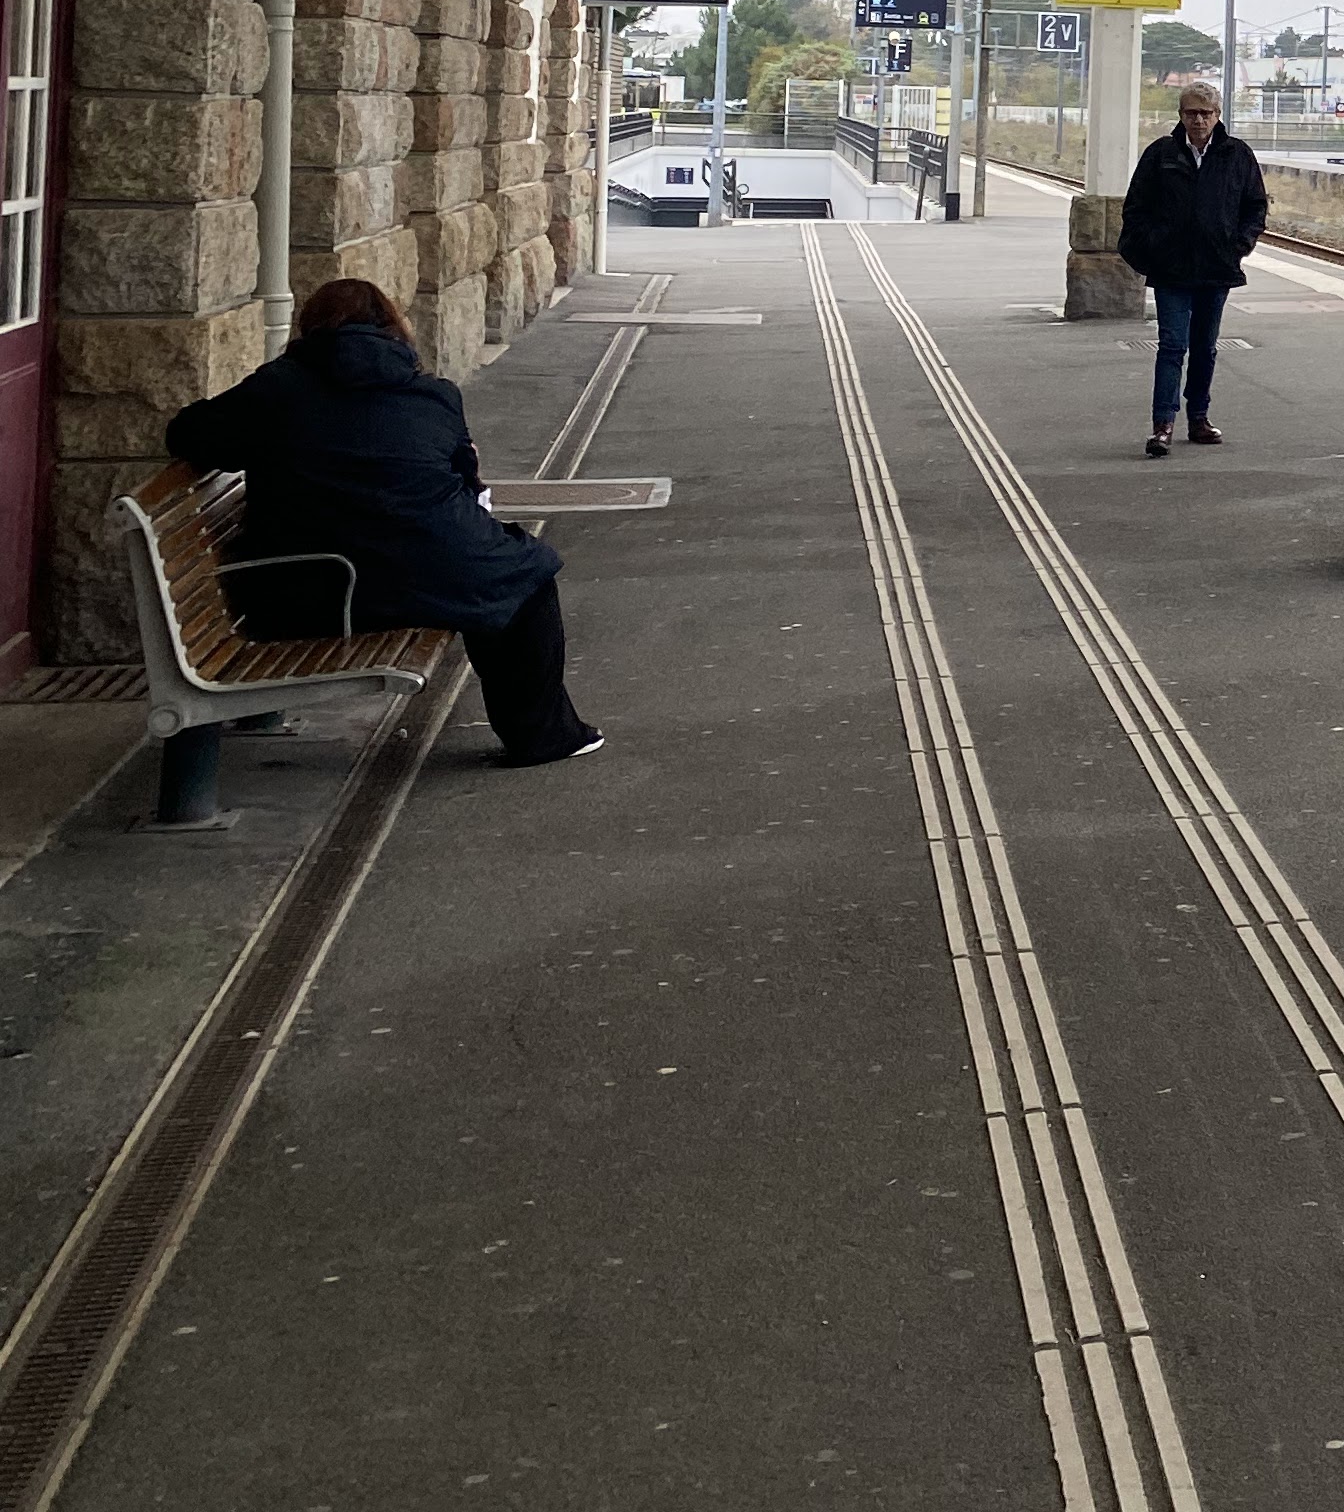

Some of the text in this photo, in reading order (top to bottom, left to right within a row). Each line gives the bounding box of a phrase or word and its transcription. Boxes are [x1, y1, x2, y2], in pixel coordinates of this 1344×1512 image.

[1044, 15, 1073, 42] 2 V
[1043, 32, 1056, 49] 4
[894, 43, 907, 59] F
